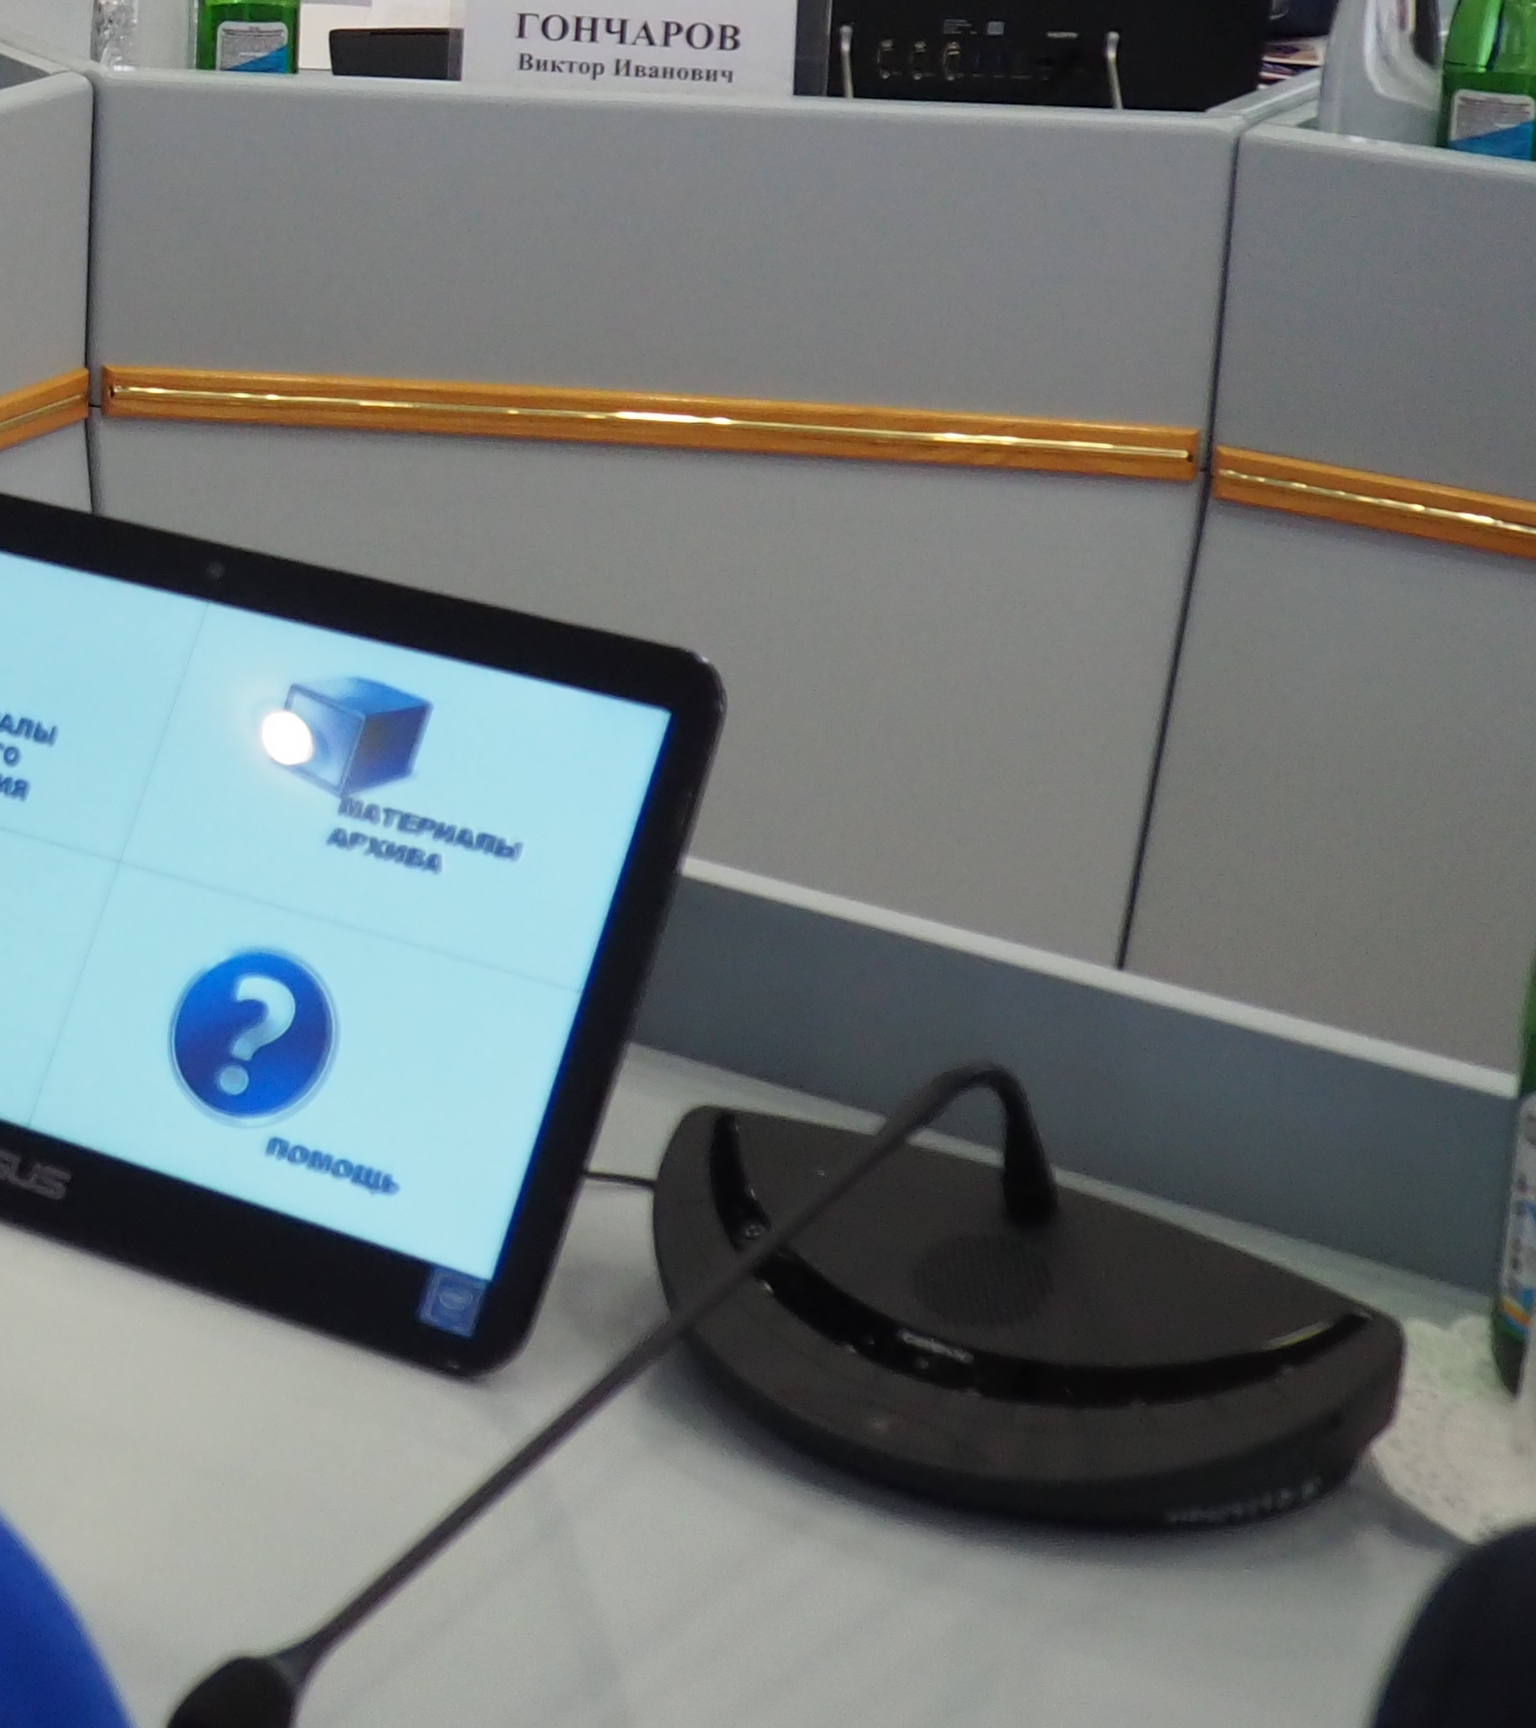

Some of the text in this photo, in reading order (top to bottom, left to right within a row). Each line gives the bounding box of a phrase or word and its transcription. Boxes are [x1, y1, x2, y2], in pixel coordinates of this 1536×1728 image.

[514, 12, 742, 52] ГОНЧАРОВ
[517, 52, 735, 84] Виктор Иванович
[326, 827, 443, 875] АРХИВА
[337, 796, 524, 863] МАТЕРИАЛЫ
[265, 1136, 401, 1196] ПОМОЩЬ
